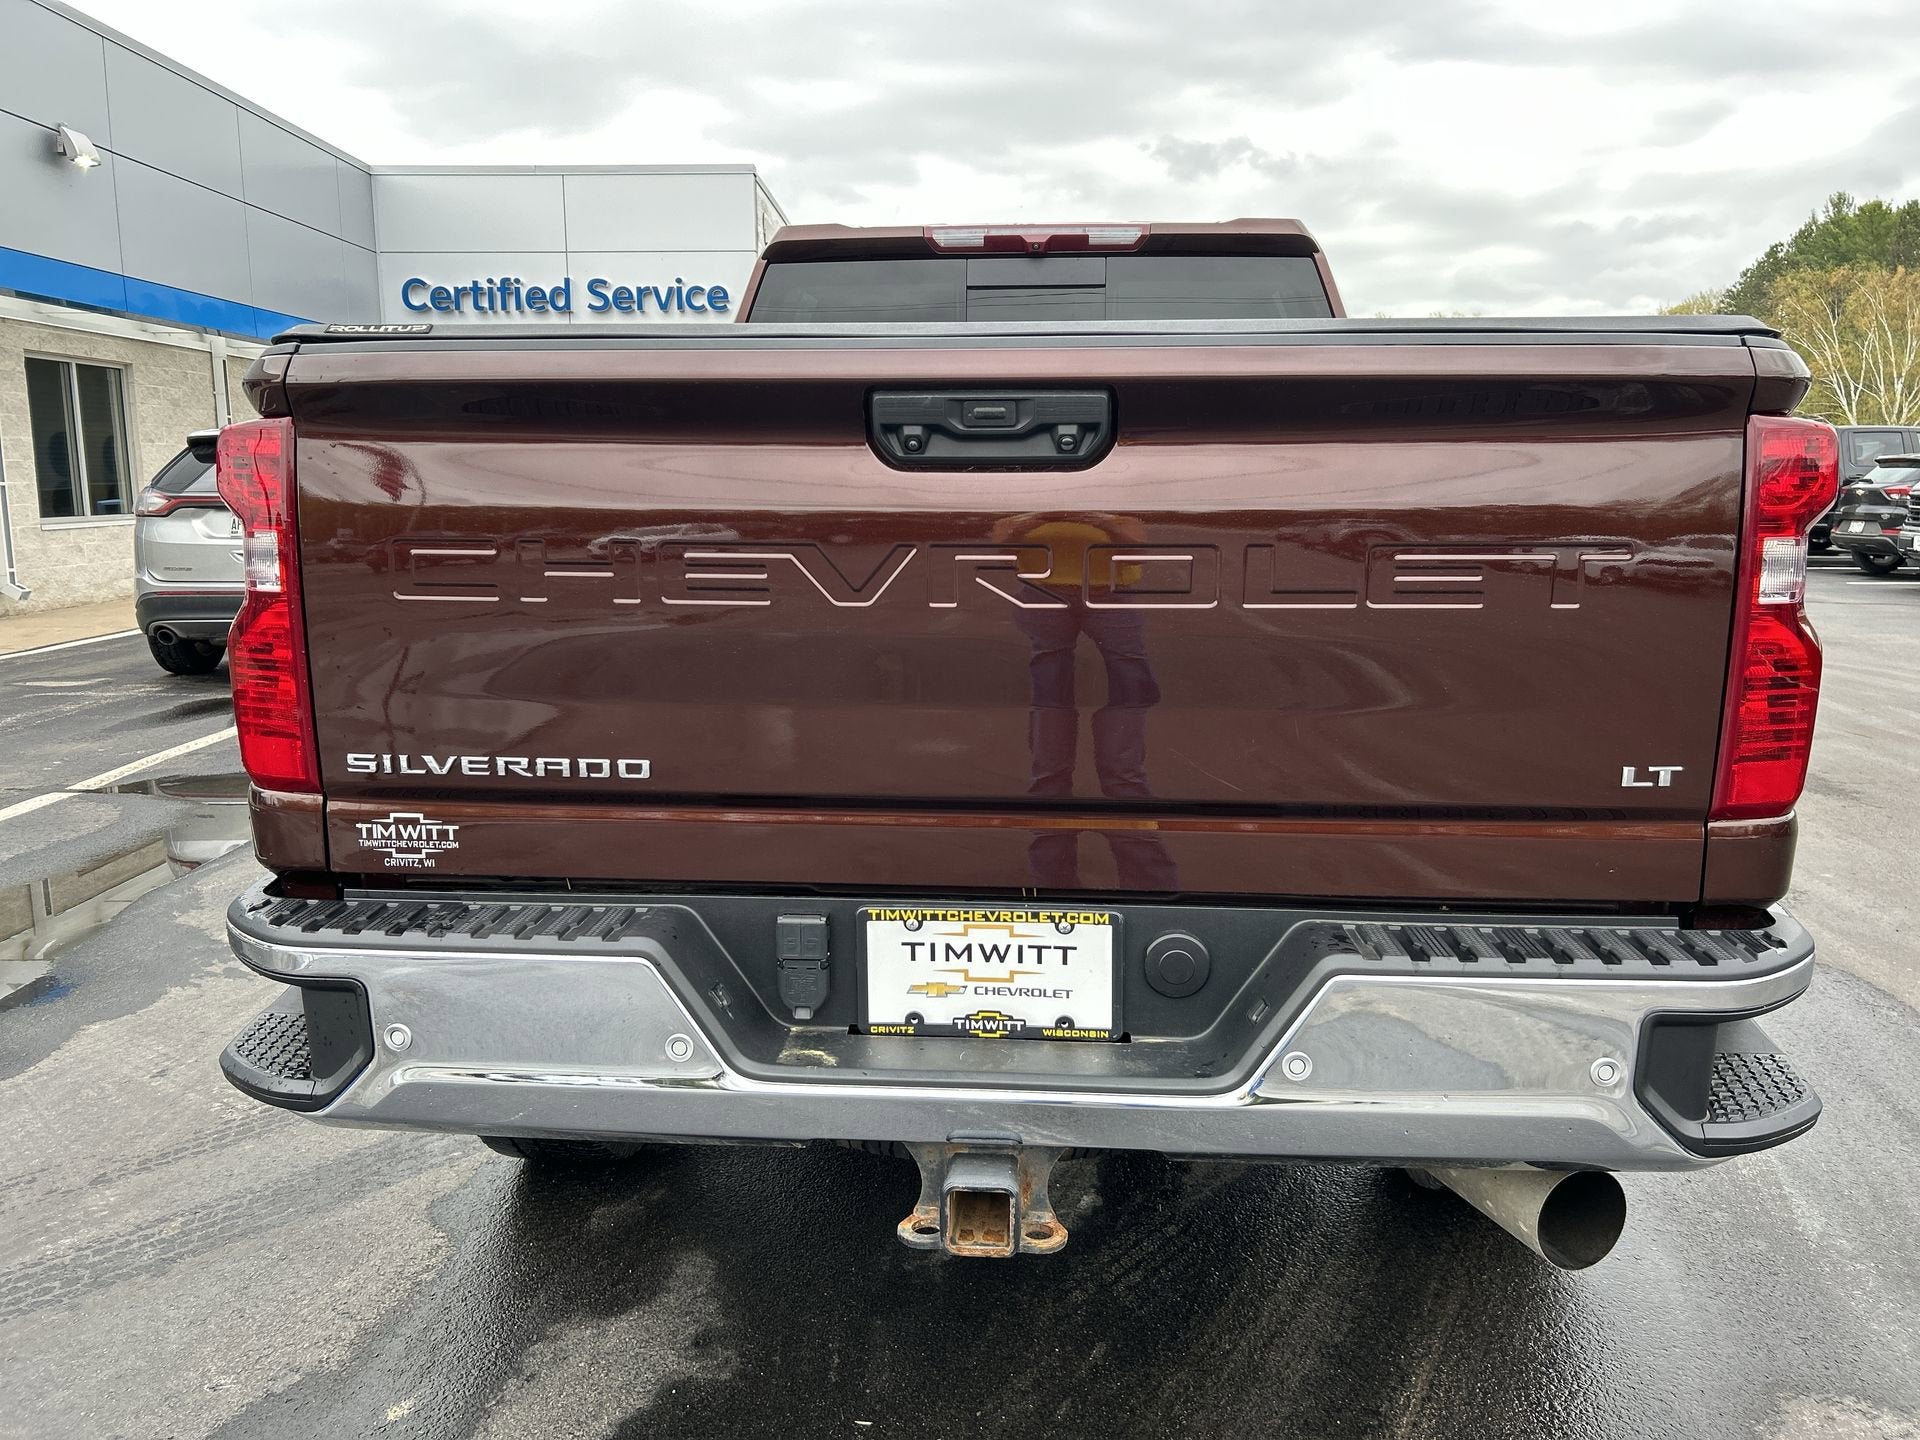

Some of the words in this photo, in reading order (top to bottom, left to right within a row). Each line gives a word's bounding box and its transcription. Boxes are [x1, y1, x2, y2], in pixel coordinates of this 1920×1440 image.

[401, 277, 572, 313] Certified
[586, 277, 730, 313] Service
[392, 537, 1635, 609] CHEVROLET
[346, 753, 651, 779] SILVERADO
[1621, 766, 1684, 787] LT
[358, 839, 460, 849] TIMWITTCHEVROLET.COM
[384, 858, 422, 868] CRIVITZ,
[423, 858, 436, 868] WI
[867, 909, 1110, 925] TIMWITTCHEVROLET.COM
[901, 941, 1078, 966] TIMWITT
[973, 985, 1074, 999] CHEVROLET
[870, 1026, 915, 1035] CRIVITZ
[953, 1019, 1025, 1032] TIMWITT
[1042, 1028, 1110, 1039] WISCONSIN
